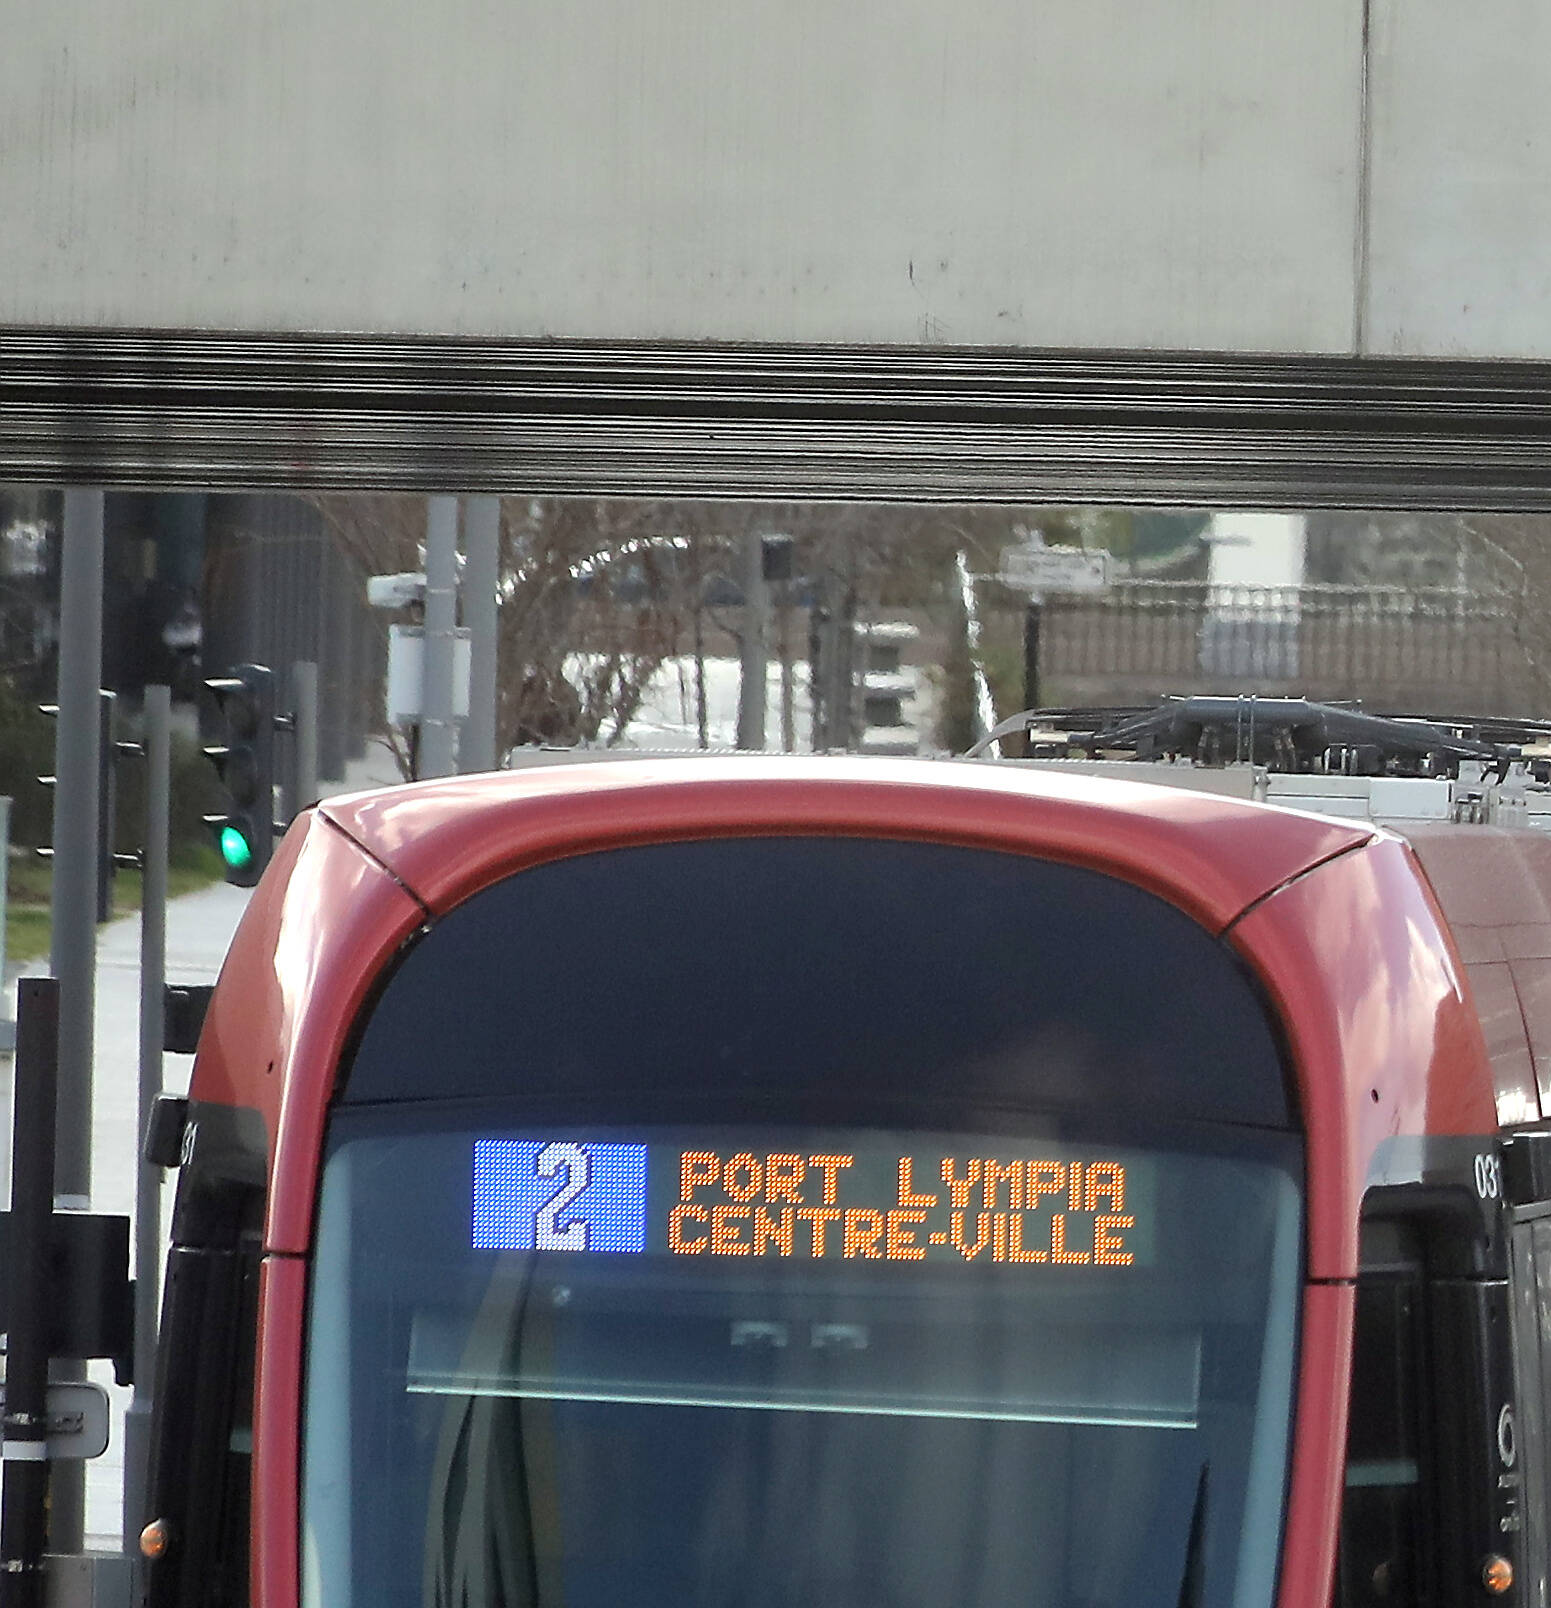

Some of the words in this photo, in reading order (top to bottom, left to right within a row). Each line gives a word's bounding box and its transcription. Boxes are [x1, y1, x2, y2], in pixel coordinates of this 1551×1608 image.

[536, 1142, 591, 1251] 2
[679, 1151, 854, 1206] PORT
[898, 1155, 1127, 1214] LYMPIA
[667, 1204, 1136, 1267] CENTRE-VILLE
